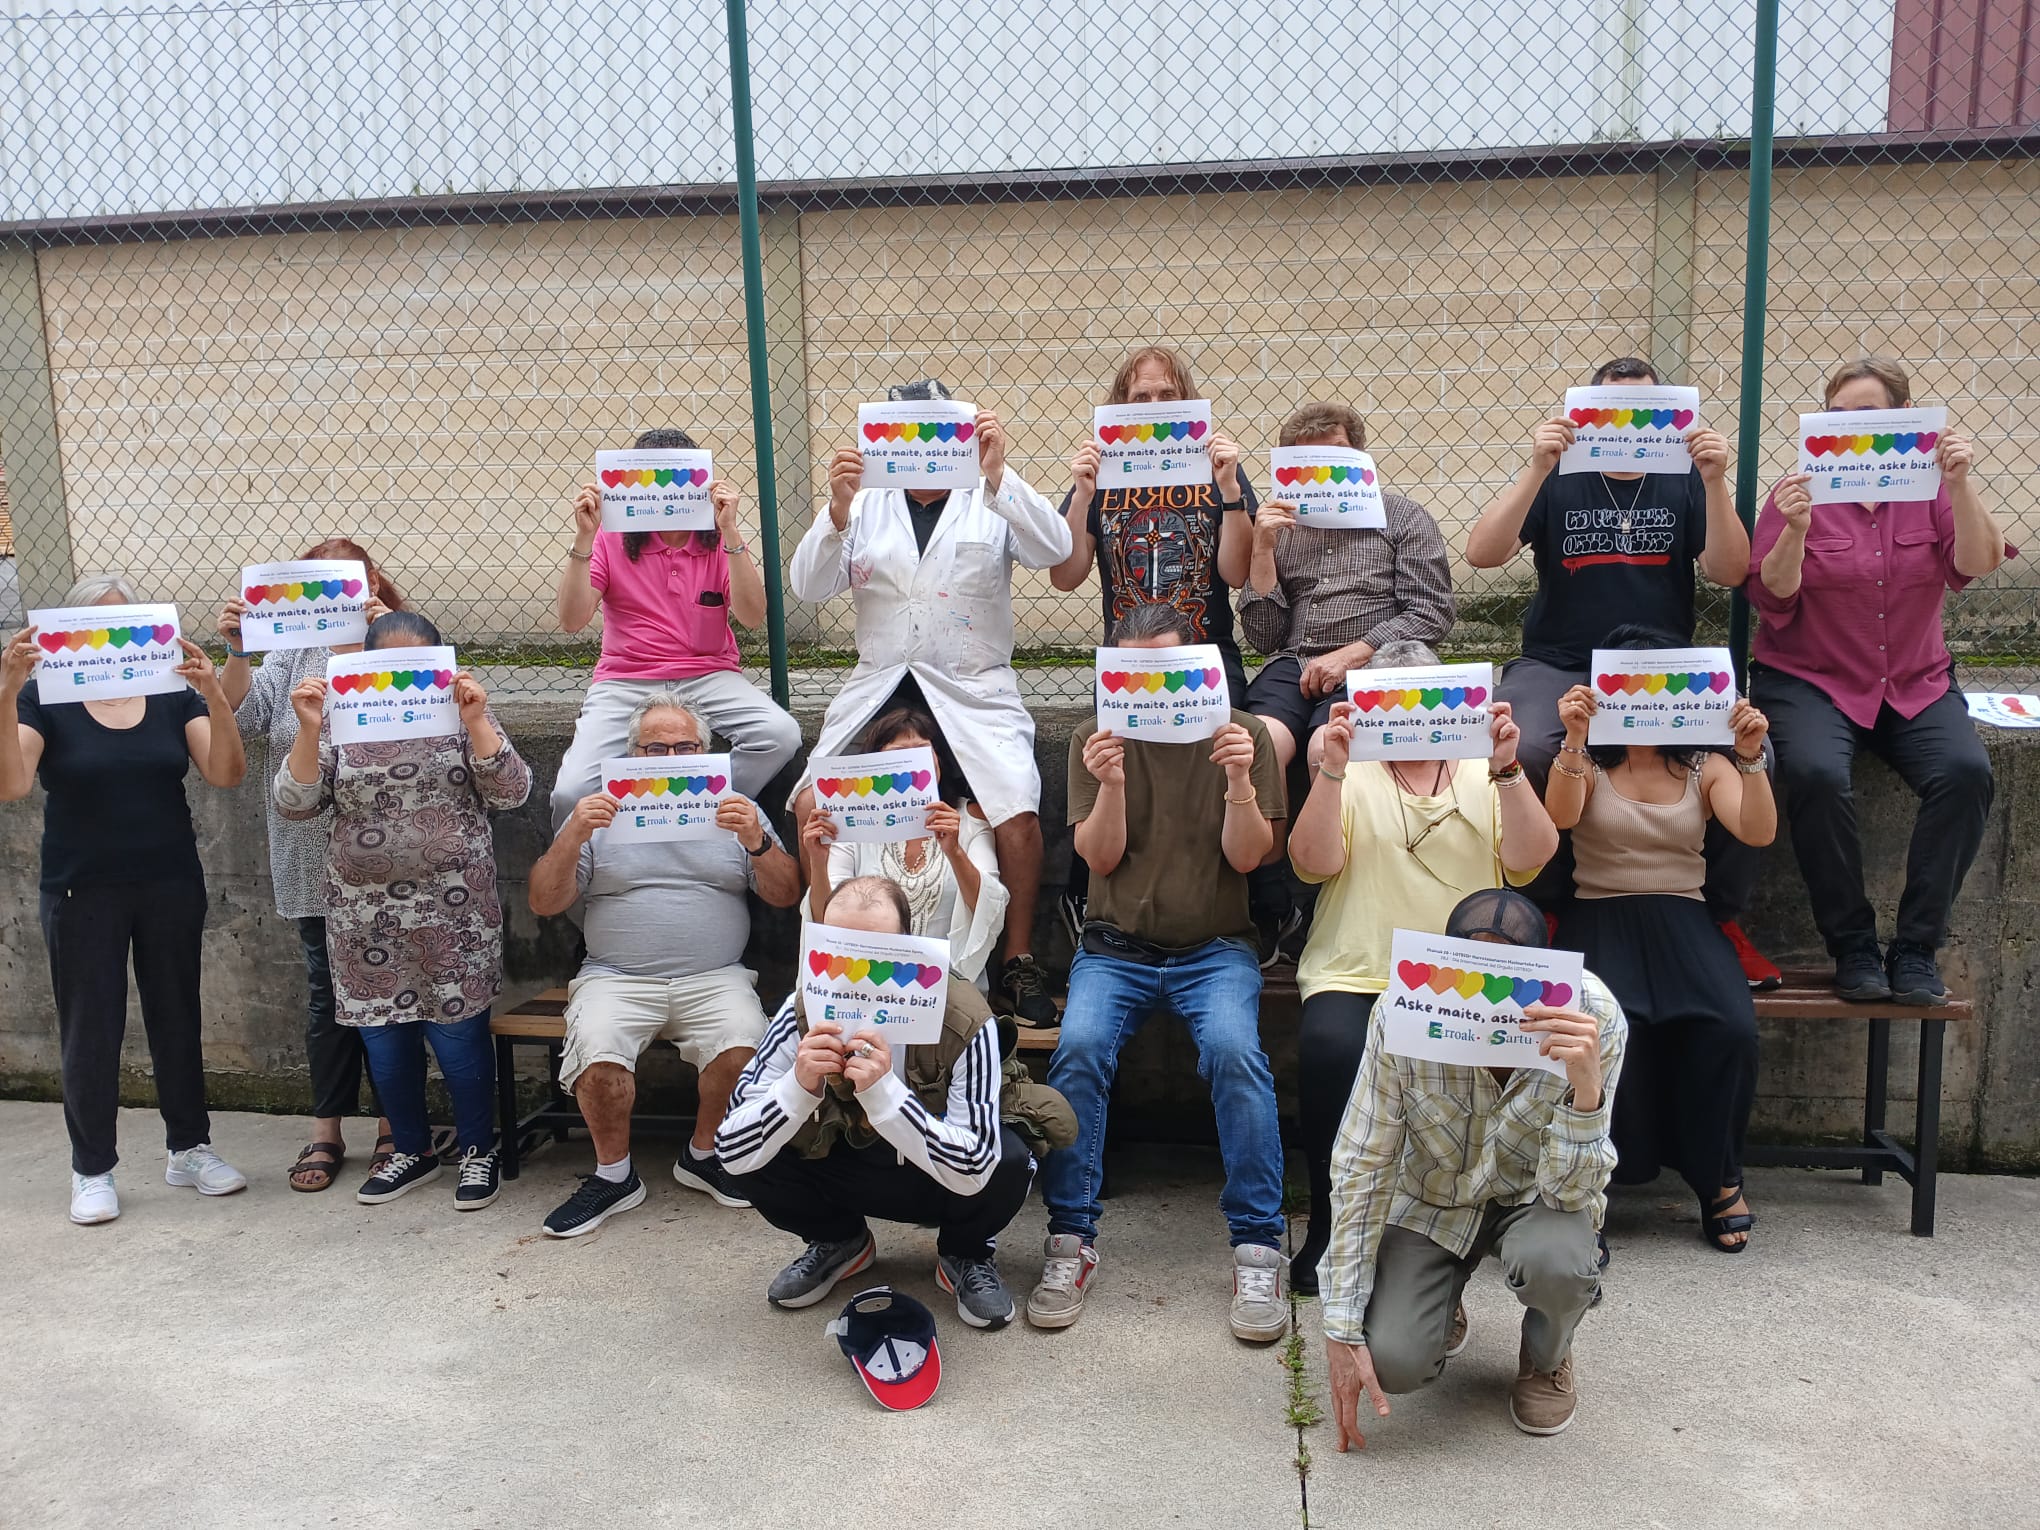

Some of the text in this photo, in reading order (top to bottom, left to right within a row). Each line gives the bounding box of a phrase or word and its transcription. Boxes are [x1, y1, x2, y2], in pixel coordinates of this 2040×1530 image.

[1576, 434, 1594, 442] ske
[1599, 435, 1632, 444] maite,
[1636, 435, 1661, 444] aske
[863, 448, 972, 457] Aske maite, aske bizi!
[1186, 445, 1206, 454] bizi!
[1804, 460, 1934, 472] Aske maite, aske bizi!
[603, 493, 626, 501] Aske
[688, 492, 707, 501] bizi!
[1277, 491, 1300, 499] Aske
[1304, 491, 1334, 499] maite,
[1361, 489, 1376, 498] bizi!
[246, 603, 363, 619] Aske maite, aske bizi!
[42, 650, 174, 669] Aske maite, aske bizi!
[333, 695, 451, 710] Aske maite, aske bizi!
[1102, 695, 1222, 709] Aske maite, aske bizi!
[1598, 700, 1728, 711] Aske maite, aske bizi!
[1354, 714, 1485, 727] Aske maite, aske bizi!
[615, 804, 636, 812] ske
[640, 803, 673, 811] maite,
[677, 801, 700, 809] aske
[822, 803, 844, 812] Aske
[848, 804, 879, 812] maite,
[883, 800, 907, 809] aske
[806, 982, 937, 1008] Aske maite, aske bizi!
[1395, 996, 1432, 1013] Aske
[1438, 1005, 1485, 1023] maite,
